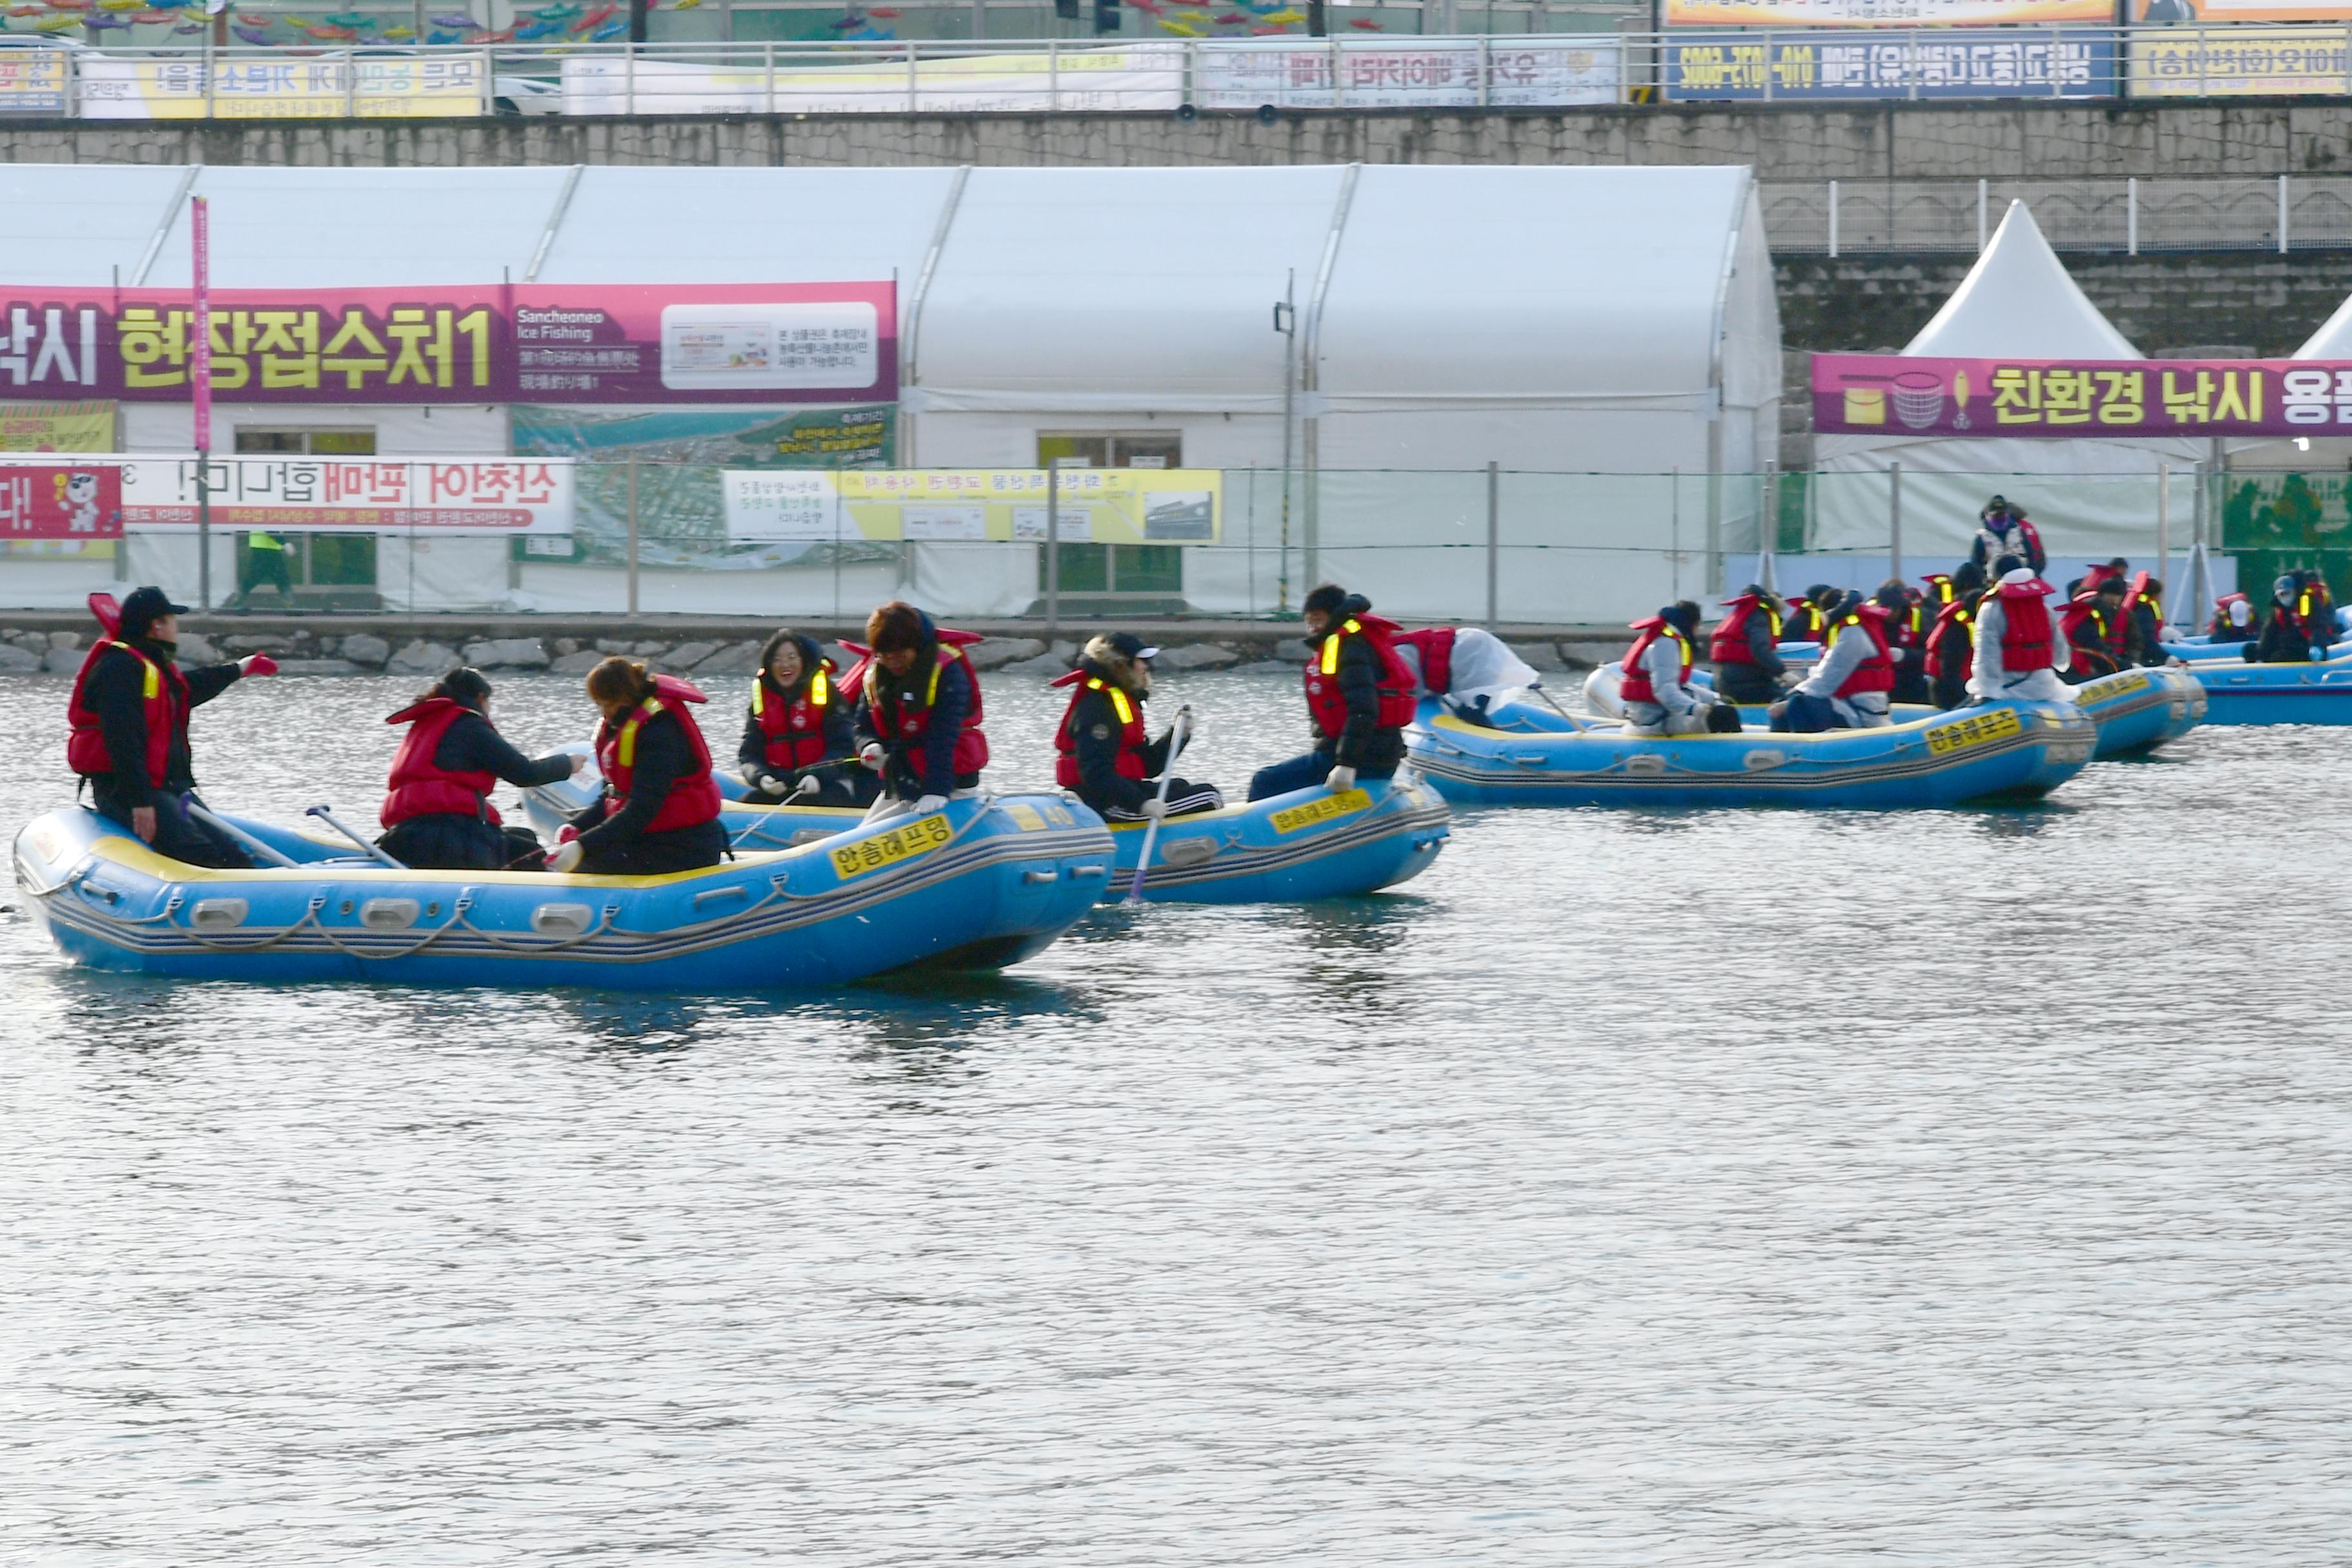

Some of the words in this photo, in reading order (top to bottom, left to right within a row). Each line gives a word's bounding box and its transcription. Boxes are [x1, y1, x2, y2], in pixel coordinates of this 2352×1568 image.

[517, 325, 539, 340] Ice
[540, 325, 593, 342] Fishing
[1992, 368, 2146, 425] 친환경
[2161, 369, 2264, 424] 낚시
[2281, 369, 2352, 425] 용
